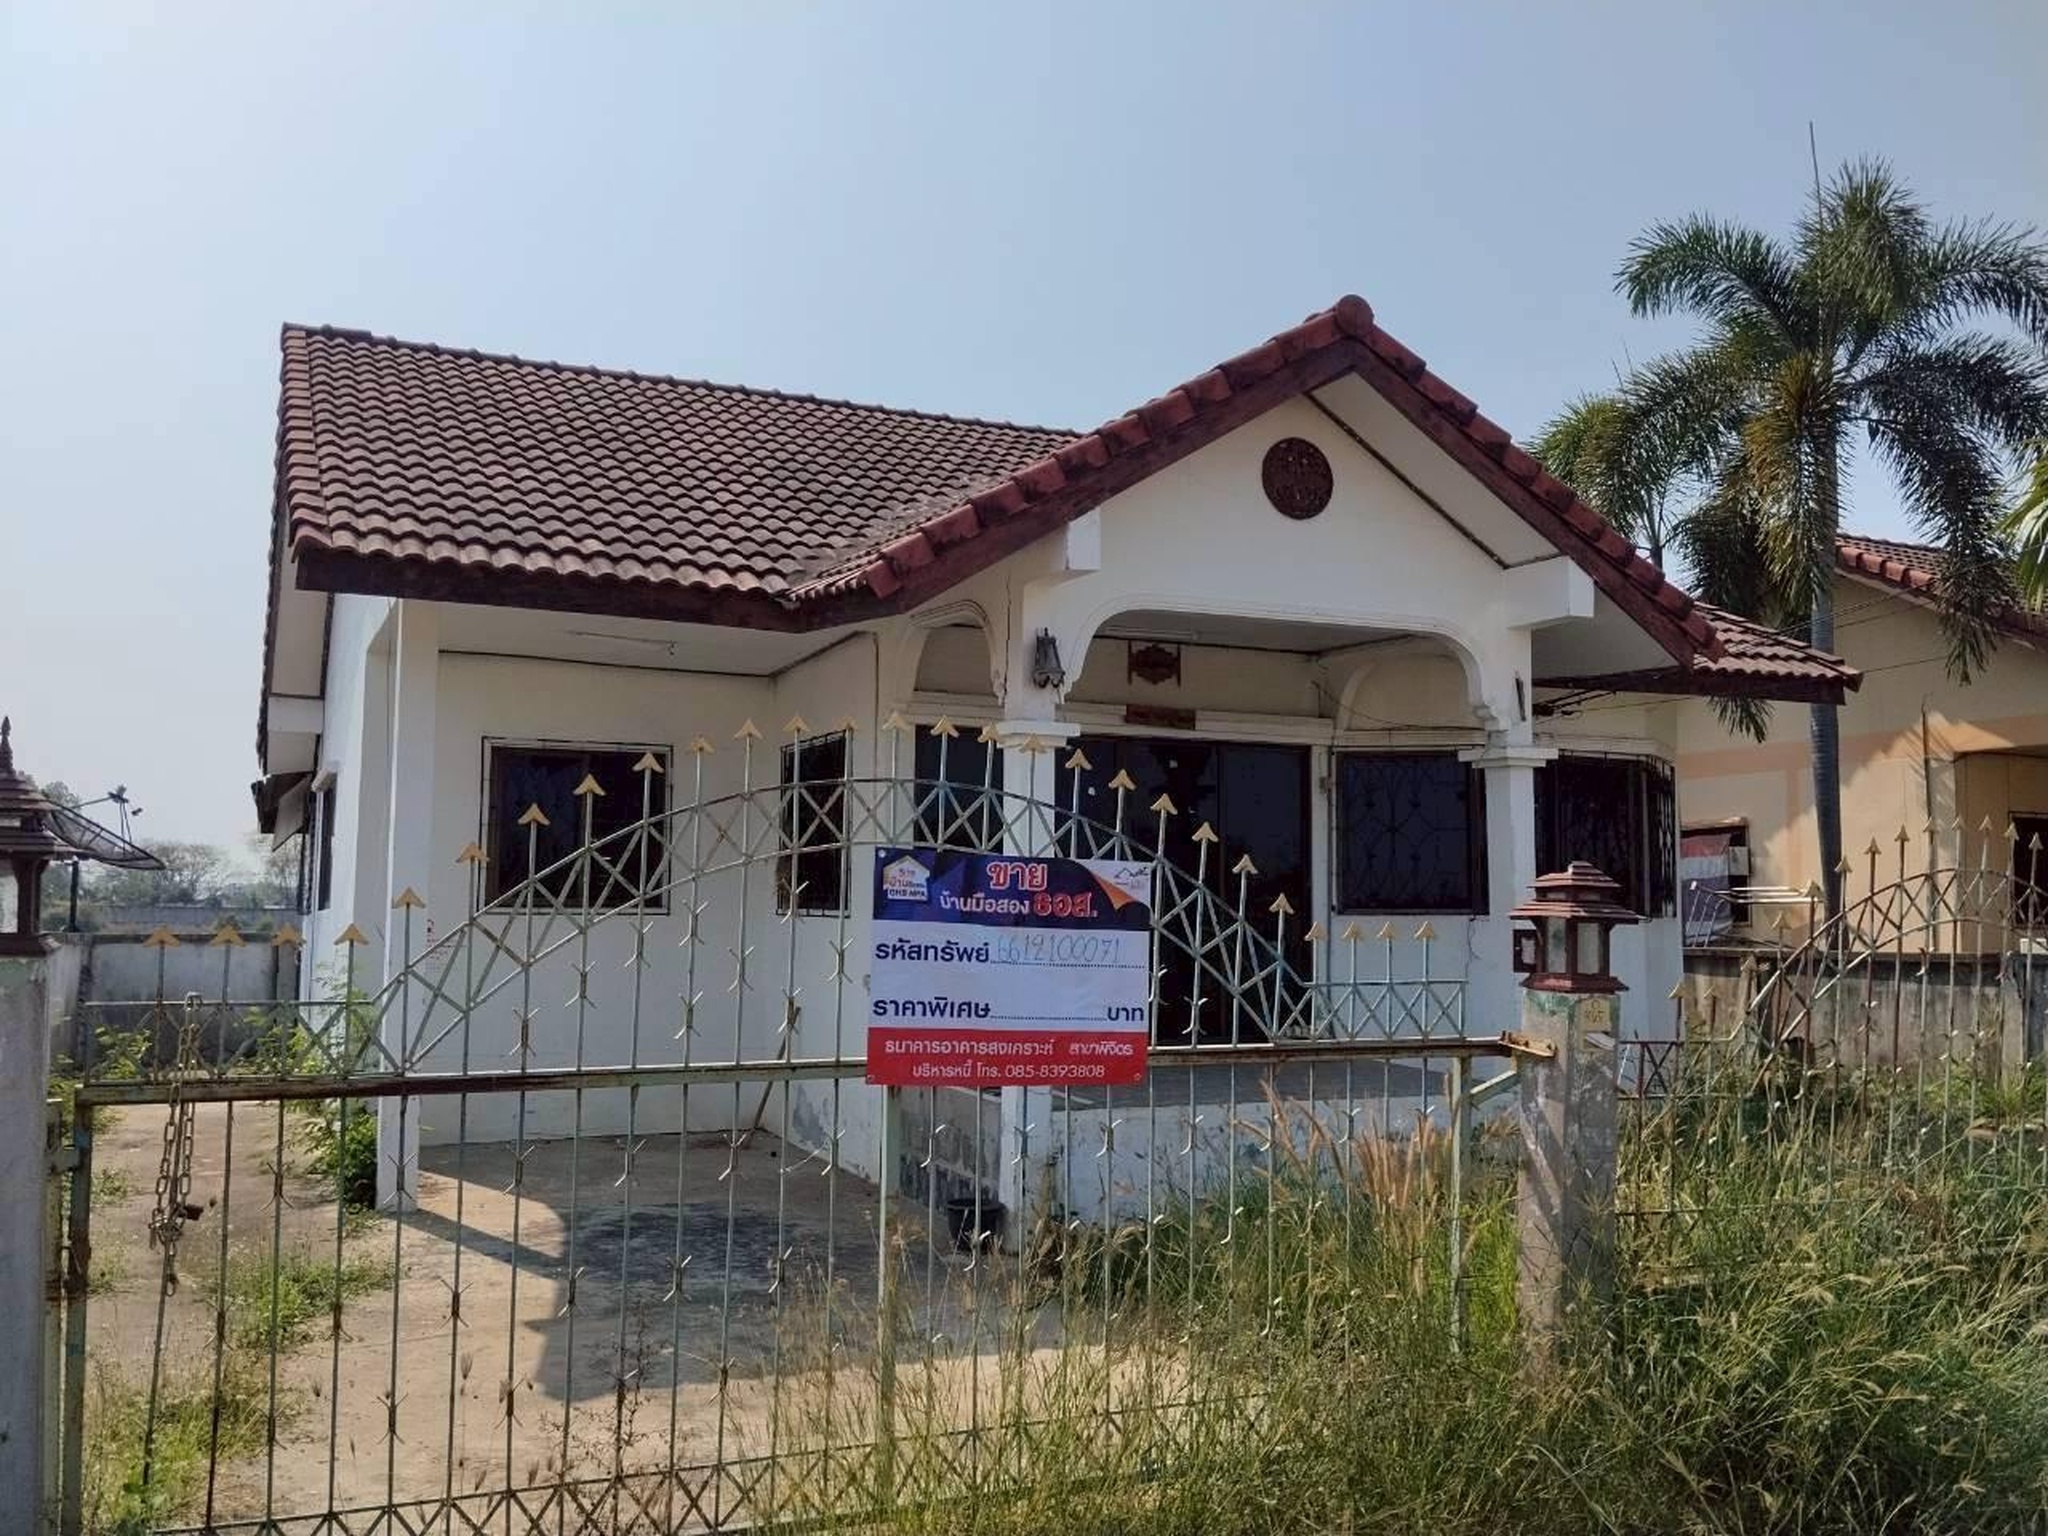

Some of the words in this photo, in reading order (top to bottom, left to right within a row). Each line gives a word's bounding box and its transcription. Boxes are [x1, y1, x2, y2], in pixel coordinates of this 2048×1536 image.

[987, 861, 1048, 891] ขาย
[939, 890, 1030, 914] บ้านมือสอง
[875, 937, 990, 963] รหัสทรัพย์
[872, 996, 991, 1018] ราคาพิเศษ
[1107, 1004, 1145, 1022] บาท
[884, 1039, 1055, 1056] ธนาคารอาคารสงเคราะห์
[976, 1061, 1001, 1078] โทร.
[1005, 1064, 1105, 1078] 085-8393808
